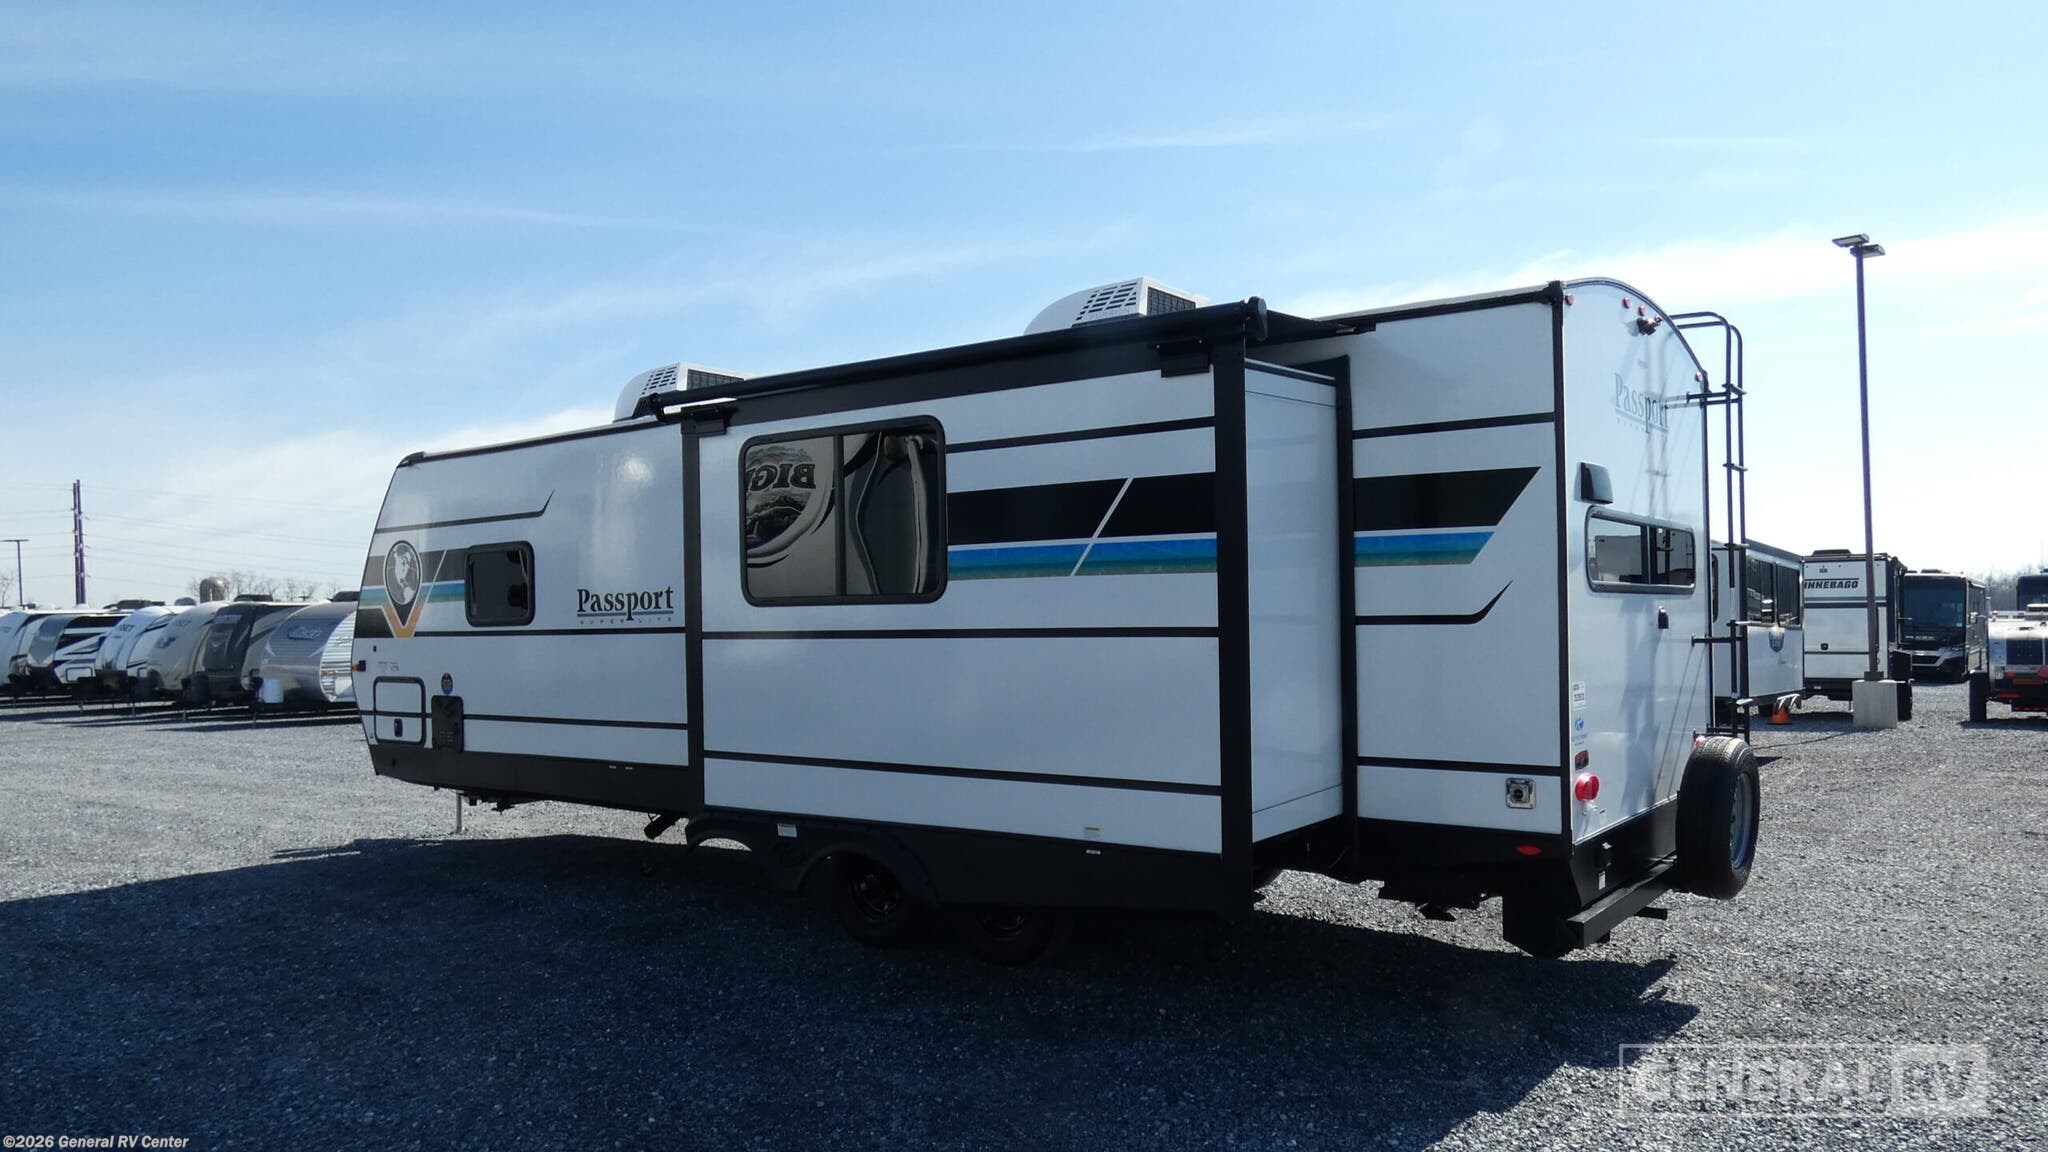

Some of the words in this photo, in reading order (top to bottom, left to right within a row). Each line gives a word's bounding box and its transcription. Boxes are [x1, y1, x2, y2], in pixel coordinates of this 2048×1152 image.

[1614, 372, 1669, 434] Passport
[1803, 580, 1859, 589] INNEBAGO
[577, 586, 674, 621] Passport
